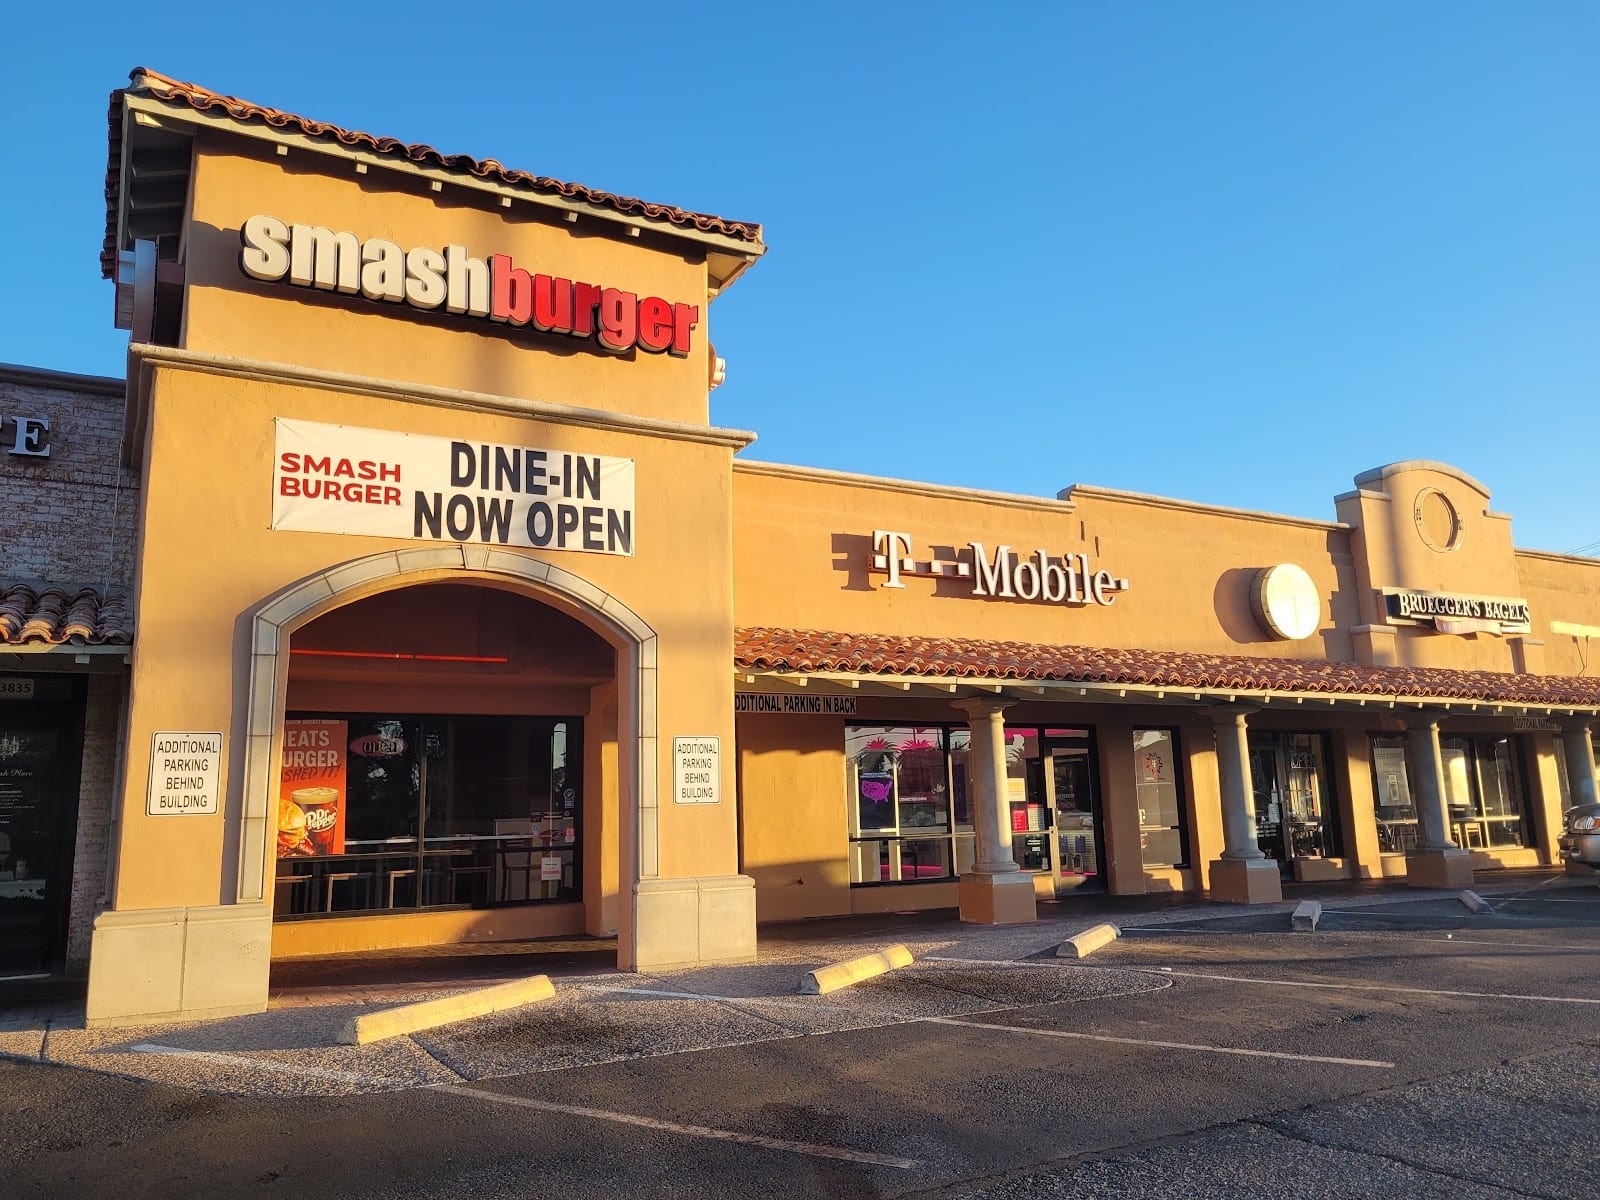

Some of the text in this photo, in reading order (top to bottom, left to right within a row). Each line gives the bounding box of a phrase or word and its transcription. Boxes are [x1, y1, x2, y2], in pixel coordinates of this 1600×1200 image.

[239, 214, 698, 357] smashburger
[0, 415, 51, 457] E
[280, 452, 401, 483] SMASH
[450, 441, 601, 501] DINE-IN
[280, 476, 402, 506] BURGER
[413, 491, 632, 553] NOW OPEN
[1400, 593, 1530, 624] BRUEGGER'S BAGELS
[735, 694, 856, 714] DDITIONAL PARKING IN BACK
[157, 740, 218, 753] ADDITIONAL
[677, 743, 718, 754] ADDITIONAL
[163, 759, 209, 771] PARKING
[282, 750, 338, 768] URGER
[682, 758, 712, 769] PARKING
[283, 766, 317, 783] SHED
[684, 772, 710, 784] BEHIND
[166, 777, 204, 790] BEHIND
[681, 787, 713, 798] BUILDING
[159, 795, 208, 808] BUILDING
